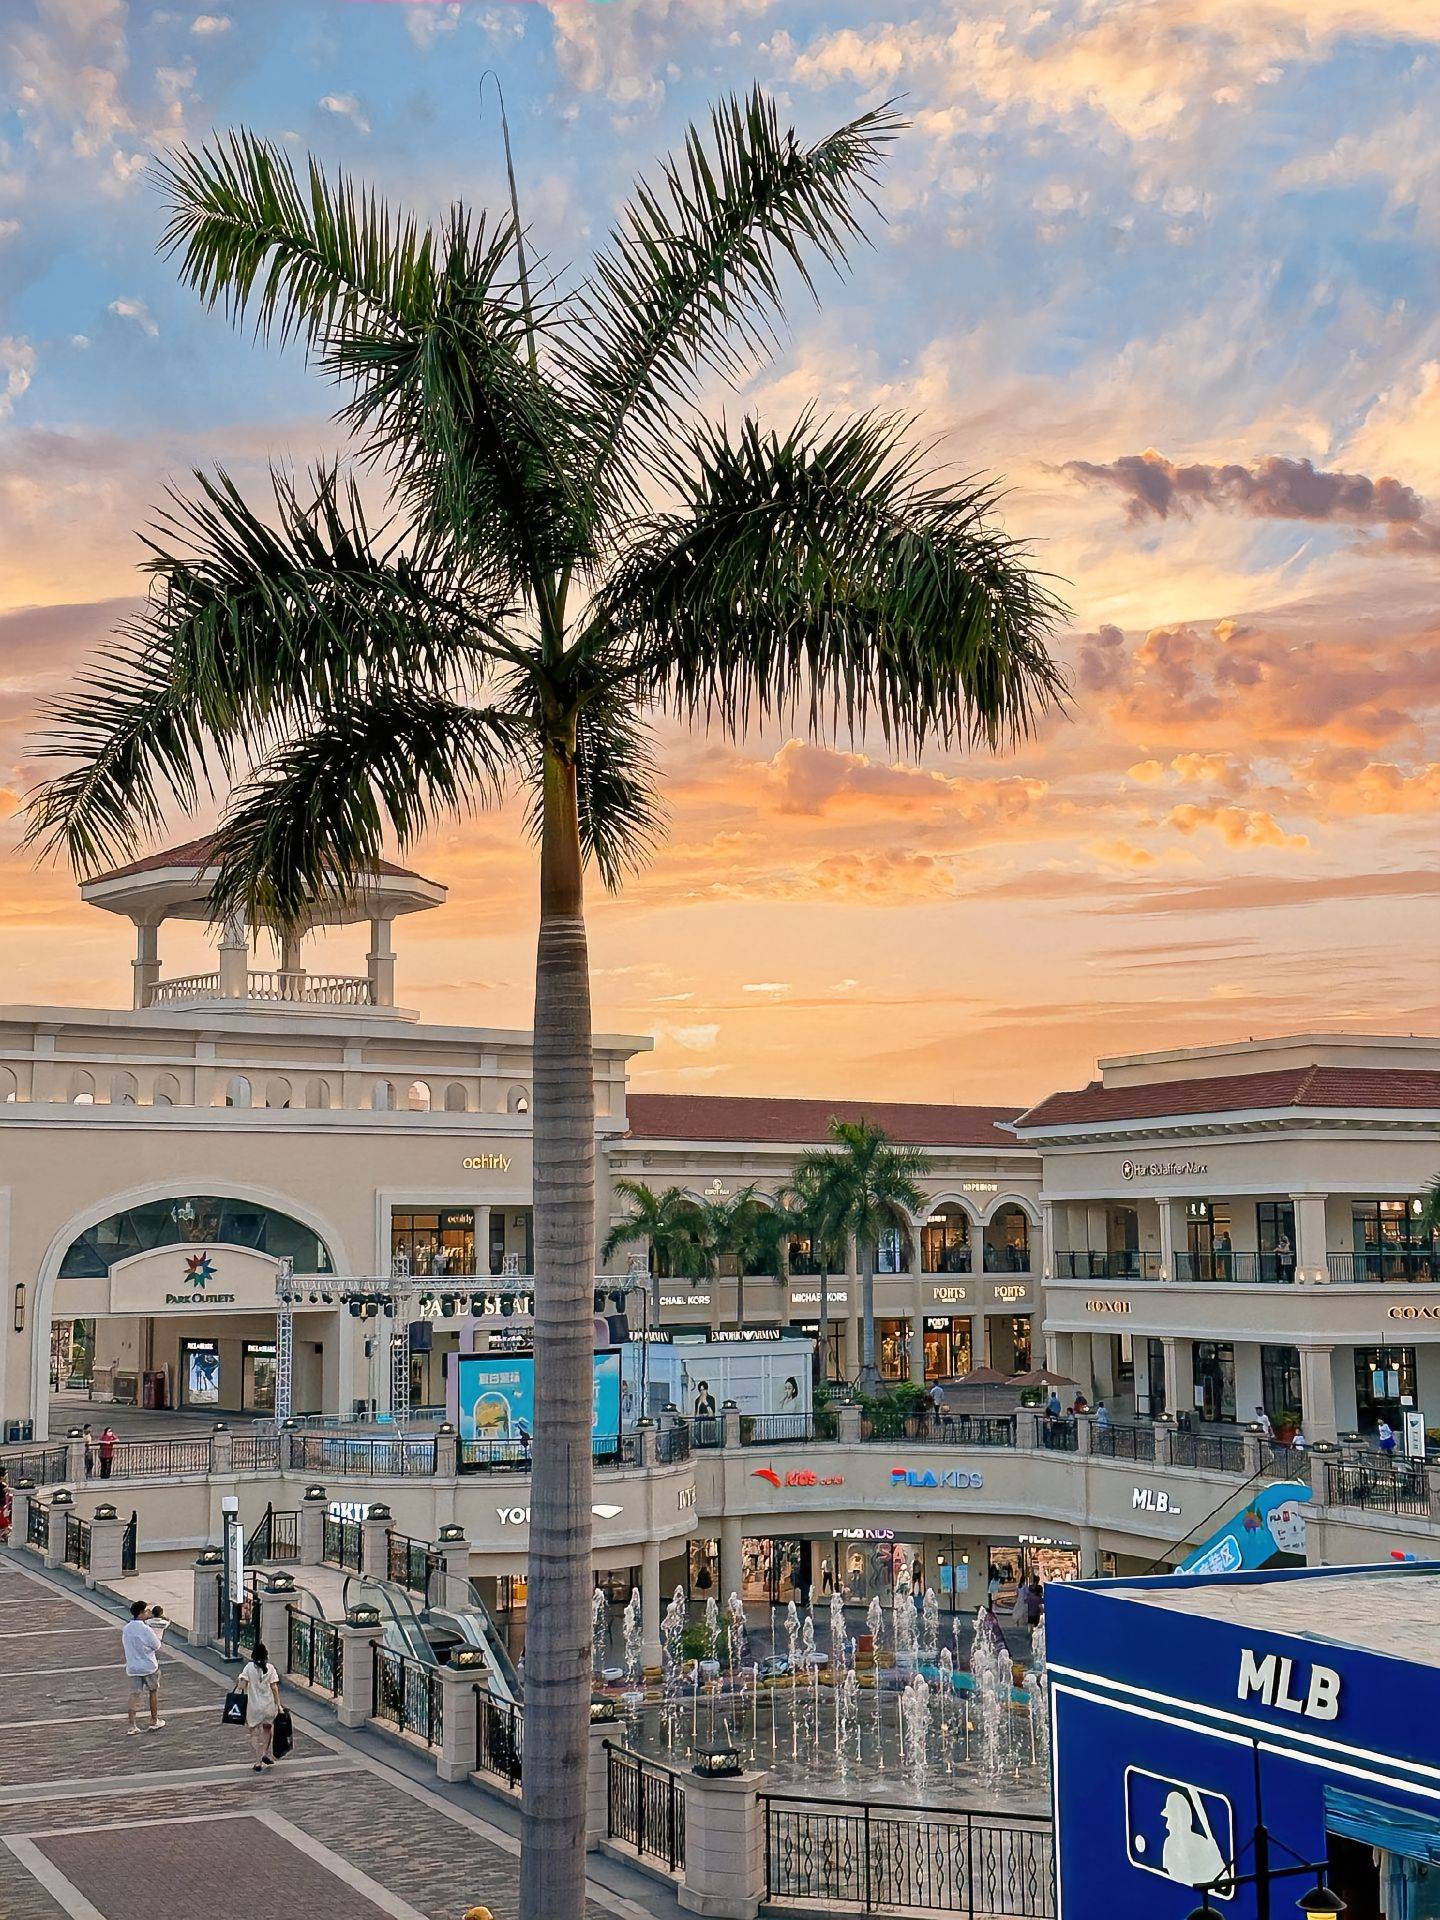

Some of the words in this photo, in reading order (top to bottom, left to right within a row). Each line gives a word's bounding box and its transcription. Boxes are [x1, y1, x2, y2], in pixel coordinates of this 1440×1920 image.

[463, 1153, 512, 1172] ochirly
[826, 1292, 848, 1302] KORS
[933, 1287, 966, 1299] PORTS
[994, 1285, 1026, 1297] PORTS
[687, 1295, 710, 1305] KORS
[1086, 1301, 1132, 1313] COACH
[889, 1468, 938, 1488] FILA
[939, 1471, 984, 1489] KIDS
[1133, 1487, 1169, 1512] MLB
[1237, 1648, 1341, 1721] MLB
